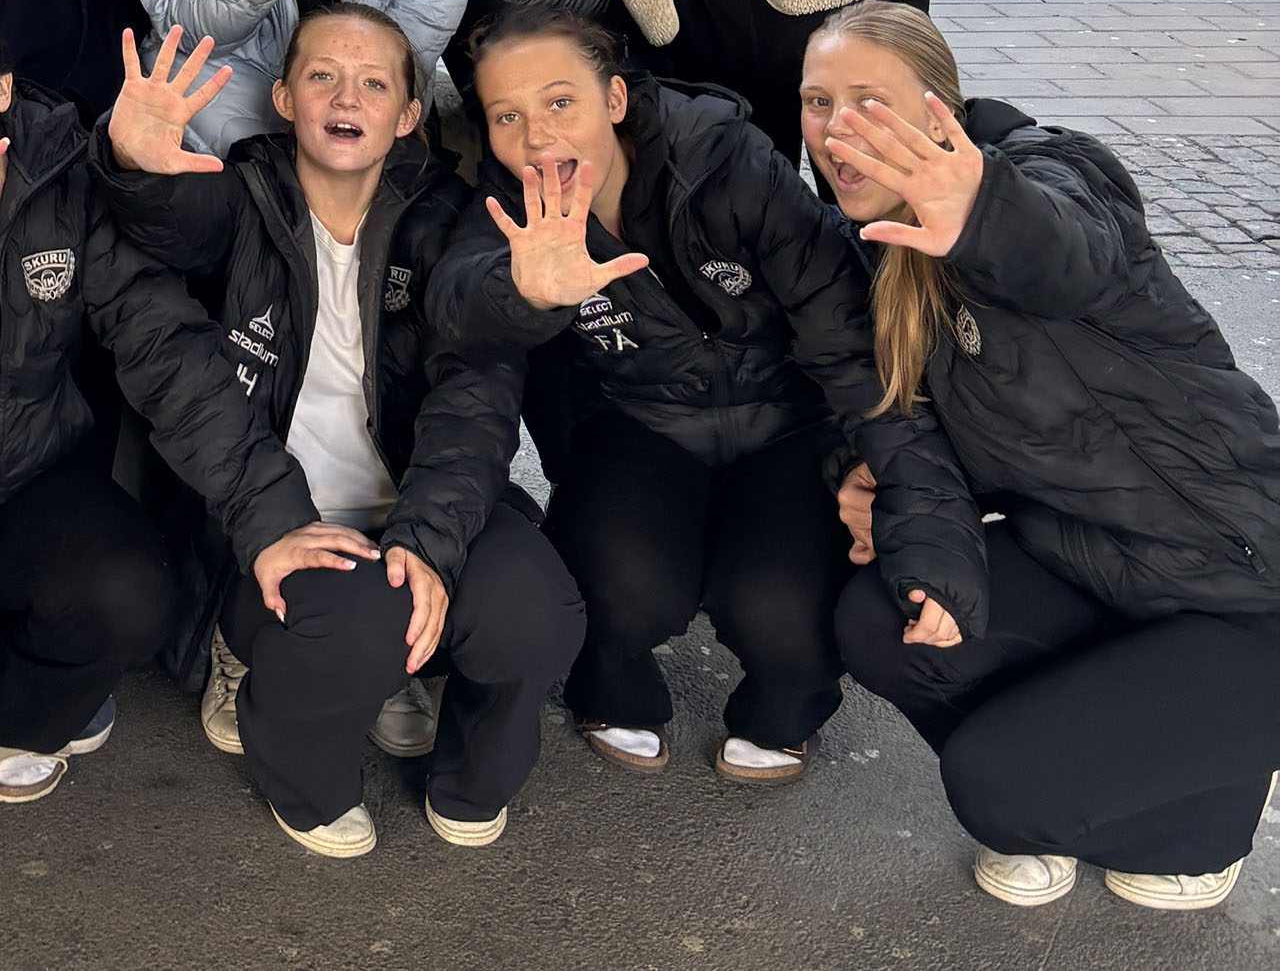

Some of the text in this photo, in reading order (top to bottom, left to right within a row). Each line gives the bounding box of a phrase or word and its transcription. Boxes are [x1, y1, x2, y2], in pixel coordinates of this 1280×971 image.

[24, 253, 66, 271] SKURU
[580, 301, 613, 317] SELECT
[248, 321, 275, 341] SELECT
[228, 329, 280, 367] stadium
